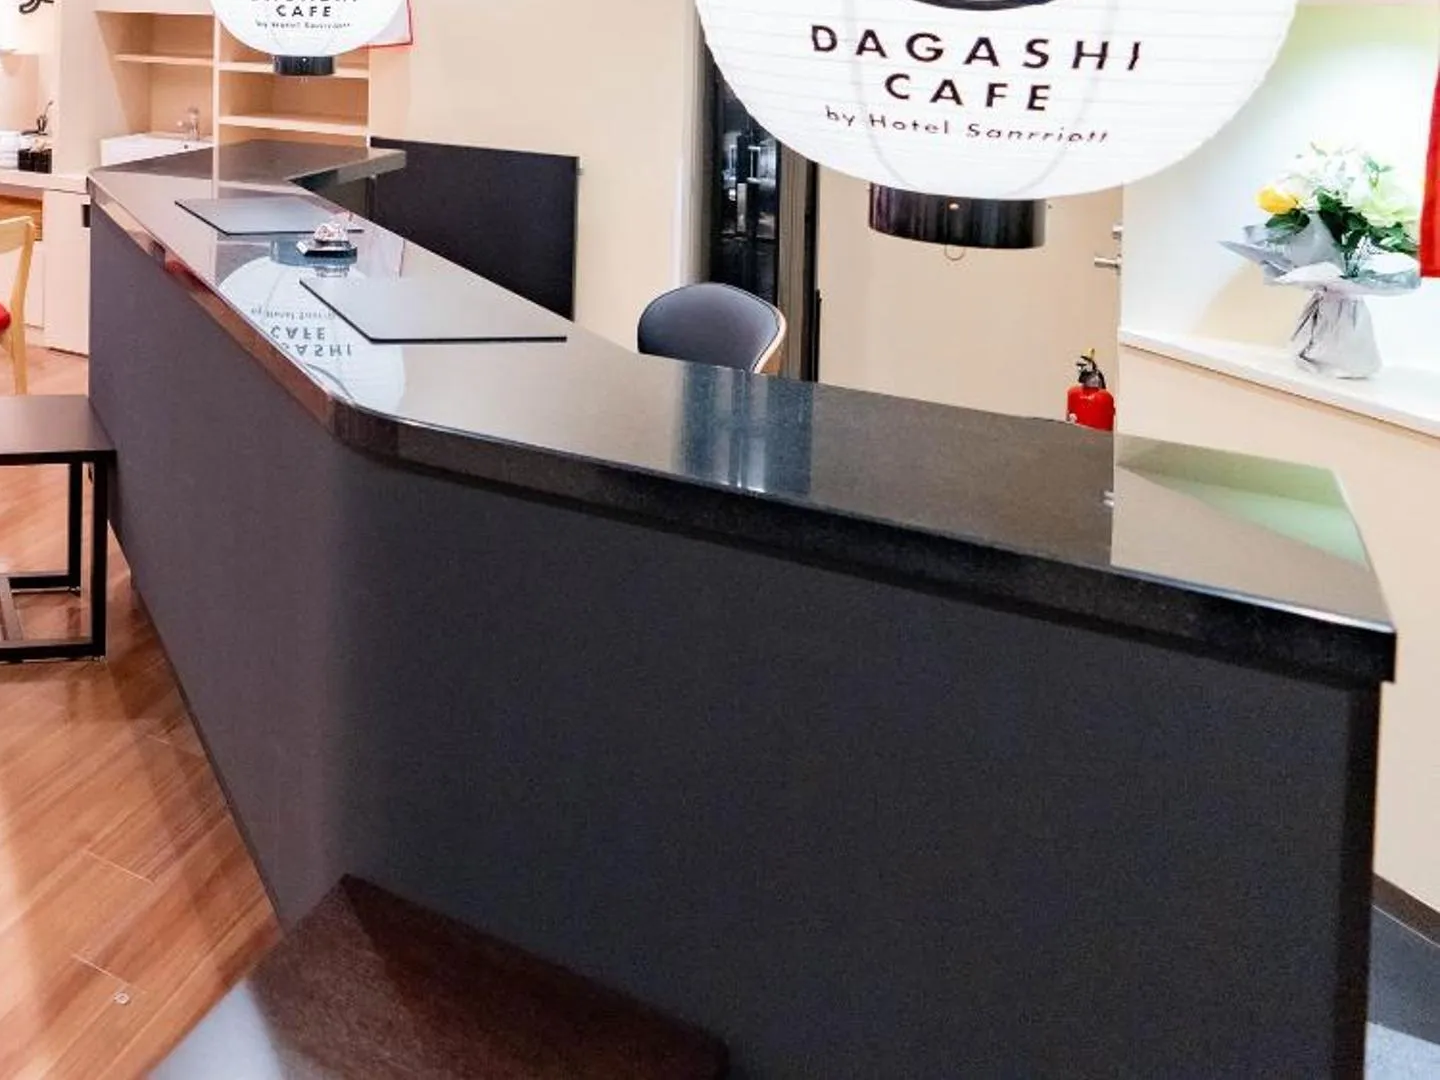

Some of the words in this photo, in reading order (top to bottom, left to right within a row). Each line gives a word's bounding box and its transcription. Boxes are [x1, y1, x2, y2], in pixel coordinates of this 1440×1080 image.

[275, 4, 332, 17] CAFE
[811, 24, 1142, 71] DAGASHI
[884, 72, 1052, 112] CAFE
[825, 105, 856, 128] by
[868, 113, 950, 135] Hotel
